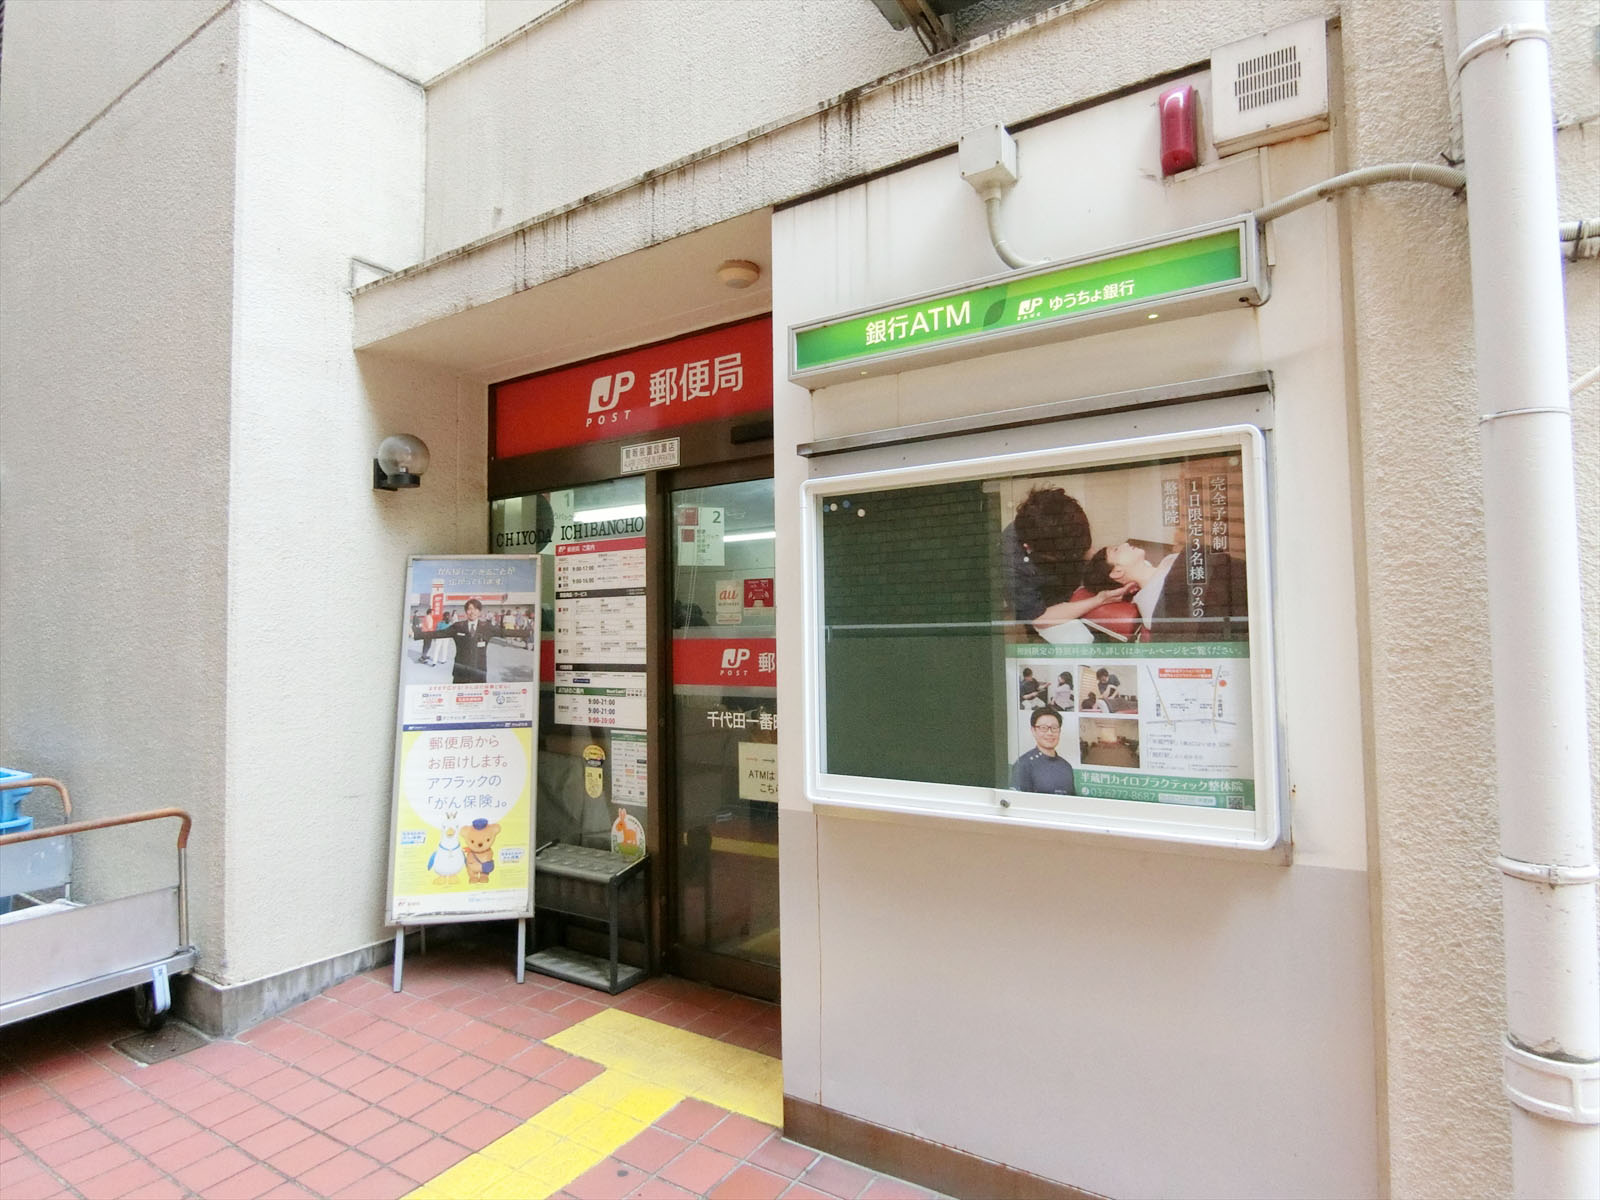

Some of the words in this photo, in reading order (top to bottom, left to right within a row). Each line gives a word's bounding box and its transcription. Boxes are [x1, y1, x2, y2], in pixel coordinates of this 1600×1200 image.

[1049, 280, 1135, 311] ゆうちょ銀行
[865, 300, 970, 346] 銀行ATM
[588, 370, 635, 413] JP
[649, 352, 743, 407] 郵便局
[586, 409, 631, 428] POST
[1164, 481, 1179, 525] 整体院
[712, 510, 721, 524] 2
[1211, 476, 1227, 551] 完全予約制
[497, 528, 553, 547] CHIYODA
[561, 516, 645, 541] ICHIBANCHO
[1188, 480, 1205, 618] 1日限定3名様のみの
[719, 590, 738, 601] au
[721, 648, 750, 669] JP
[429, 735, 500, 750] 郵便局から
[428, 755, 508, 770] お届けします。
[427, 775, 502, 790] アフラックの
[748, 769, 776, 781] ATMは
[428, 794, 508, 810] 「がん保険」。
